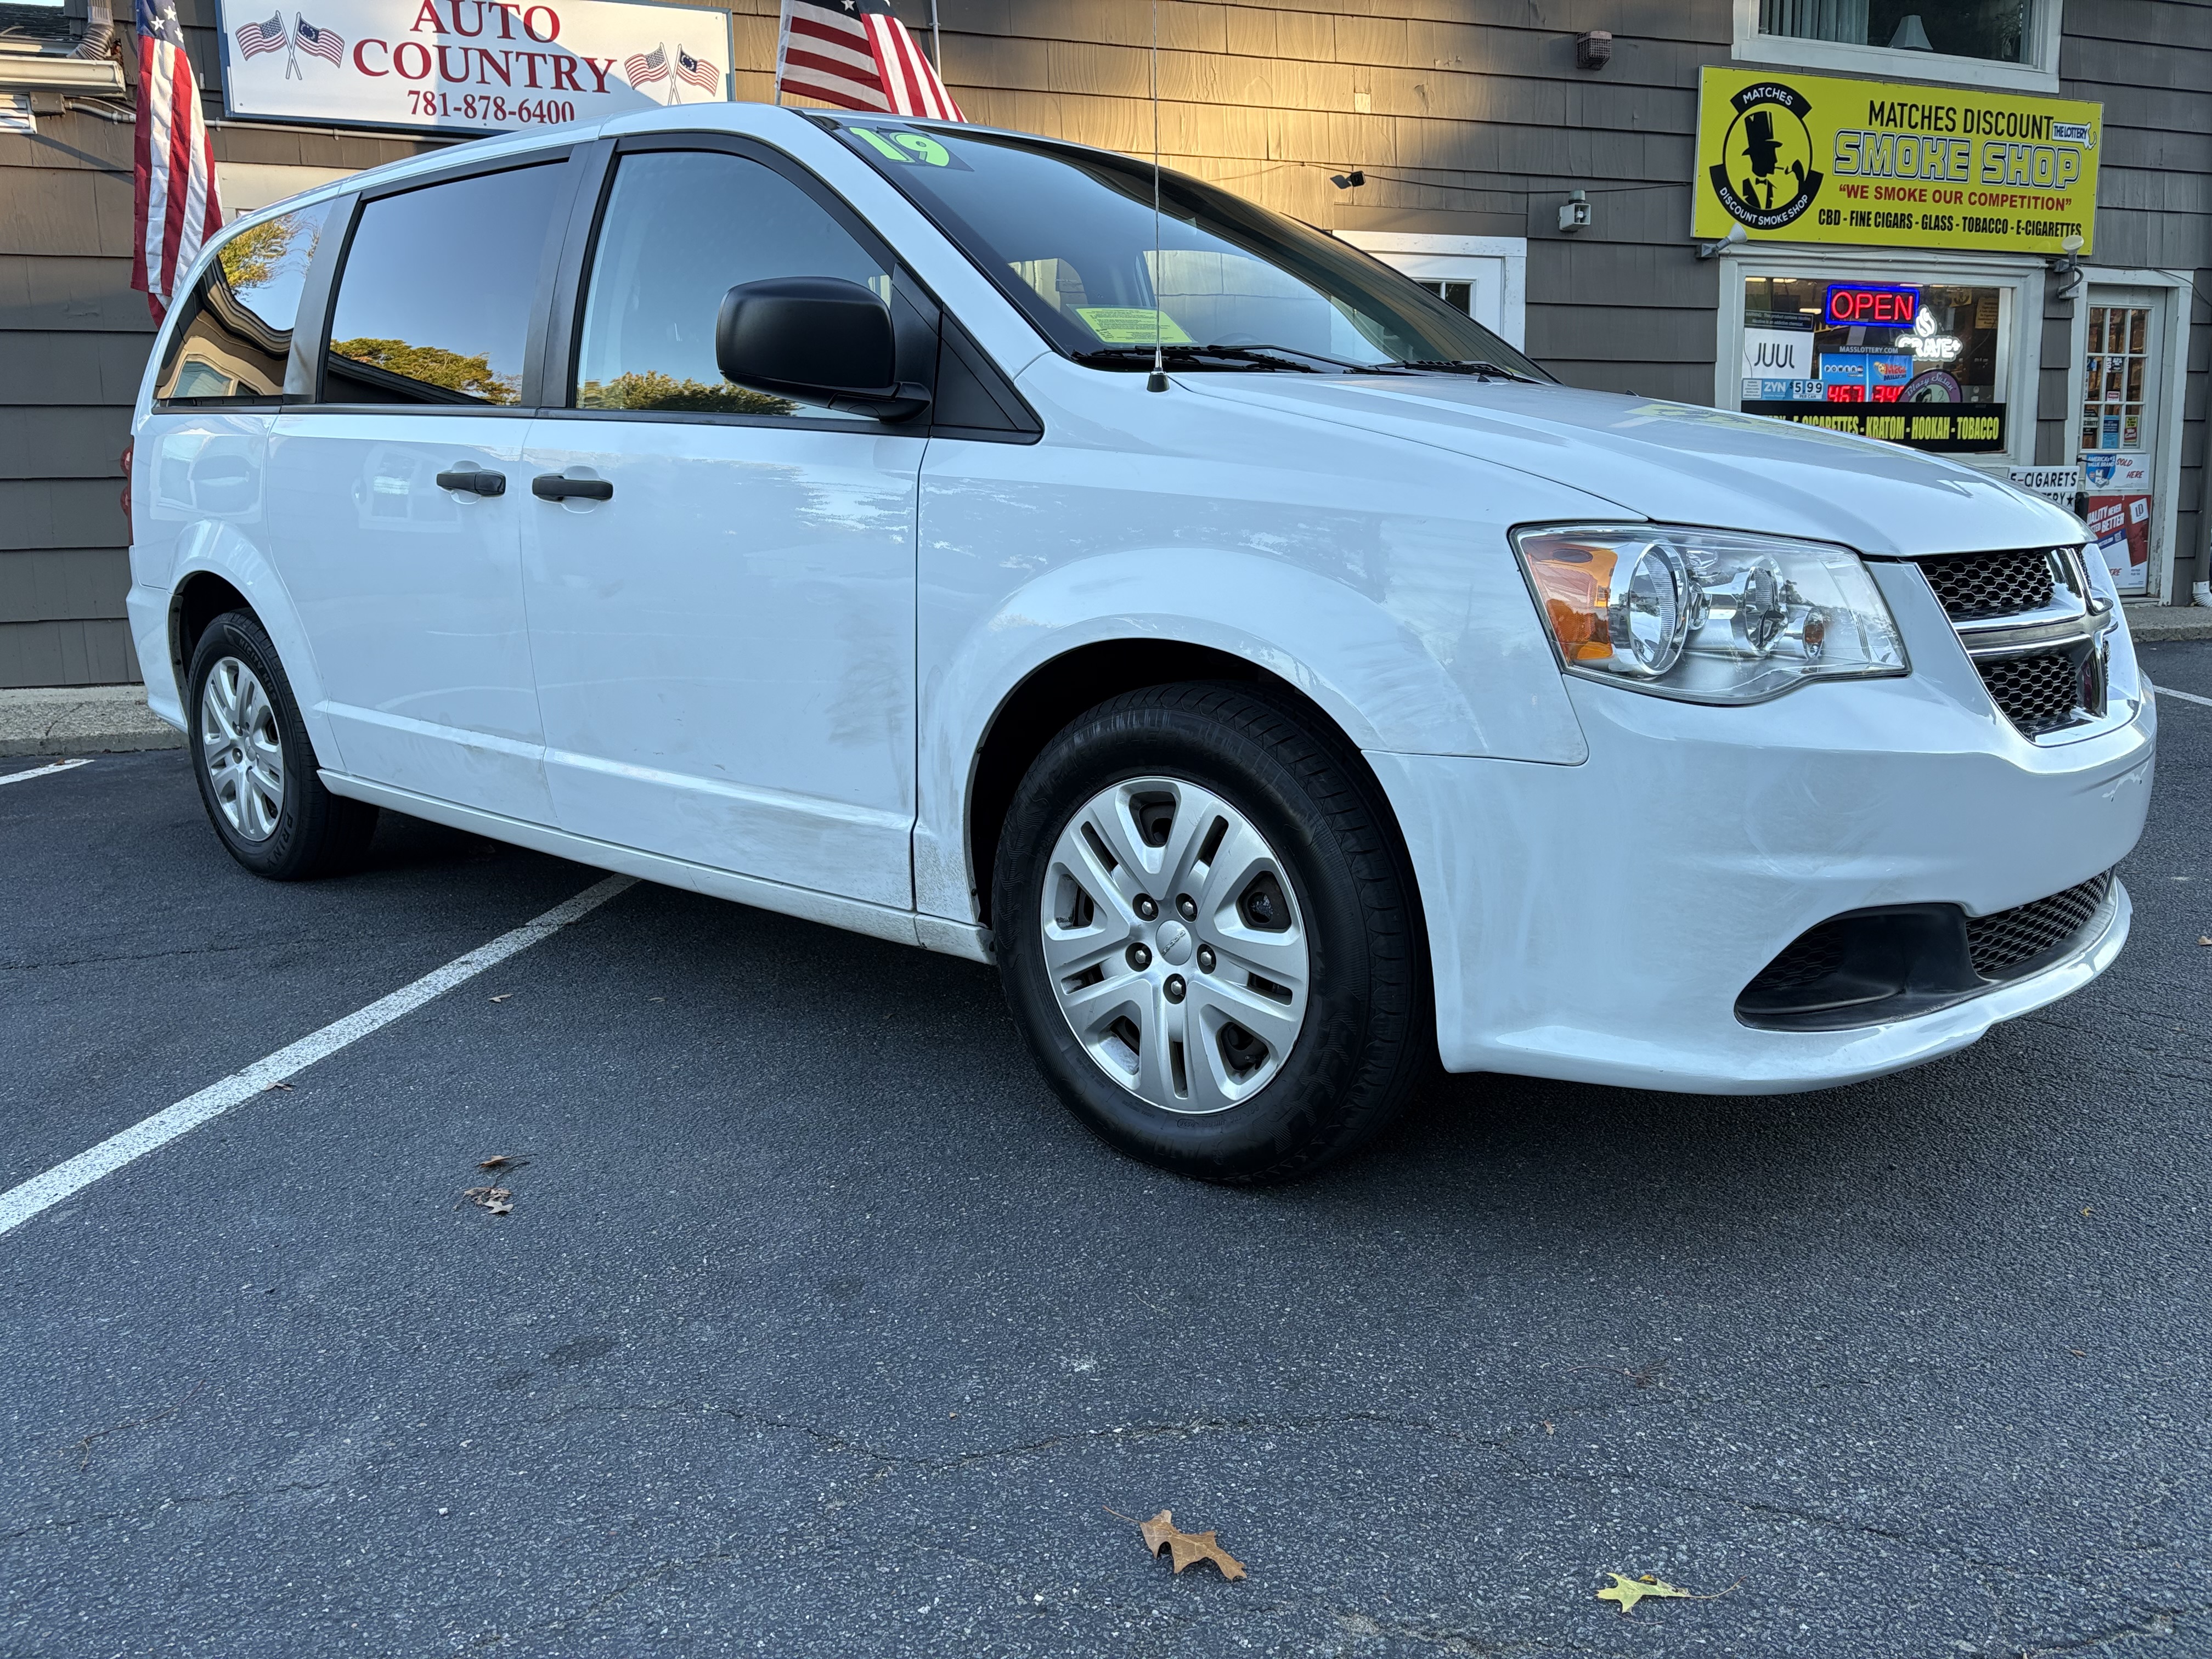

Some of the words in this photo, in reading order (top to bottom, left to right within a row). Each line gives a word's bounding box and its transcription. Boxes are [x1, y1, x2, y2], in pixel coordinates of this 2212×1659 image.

[410, 0, 560, 43] AUTO
[353, 38, 618, 94] COUNTRY
[407, 90, 575, 125] 781-878-6400
[1742, 87, 1793, 106] MATCHES
[1869, 100, 1957, 133] MATCHES
[1963, 108, 2054, 140] DISCOUNT
[2054, 126, 2064, 137] THE
[2064, 127, 2088, 139] LOTTERY
[849, 127, 950, 167] 19
[1833, 128, 1972, 184] SMOKE
[1980, 140, 2082, 191] SHOP
[1719, 187, 1757, 224] DISCOUNT
[1758, 213, 1788, 226] SMOKE
[1788, 195, 1809, 218] SHOP
[1874, 186, 1927, 202] SMOKE
[1932, 189, 1963, 205] OUR
[1818, 208, 1841, 225] CBD
[1849, 210, 1872, 227] FINE
[1874, 211, 1913, 229] CIGARS
[1921, 214, 1954, 232] GLASS
[1962, 216, 2008, 234] TOBACCO
[2016, 219, 2082, 238] E-CIGARETTES
[1831, 291, 1914, 321] OPEN
[1754, 342, 1795, 369] JUUL
[1885, 363, 1907, 375] MEGA
[1764, 381, 1786, 392] ZYN
[1828, 386, 1862, 402] 467
[1906, 377, 1930, 397] Blazy
[1931, 372, 1954, 392] Susan
[1866, 416, 1905, 439] KRATOM
[1911, 416, 1951, 439] HOOKAH
[1957, 416, 2000, 440] TOBACCO
[2116, 458, 2133, 467] SOLD
[2126, 470, 2145, 478] HERE
[2010, 472, 2078, 488] E-CIGARETS
[2087, 505, 2108, 525] UALITY
[2101, 512, 2125, 533] BETTER
[238, 638, 264, 669] HICITY
[266, 811, 294, 868] PRINX
[1161, 929, 1186, 956] DODGE
